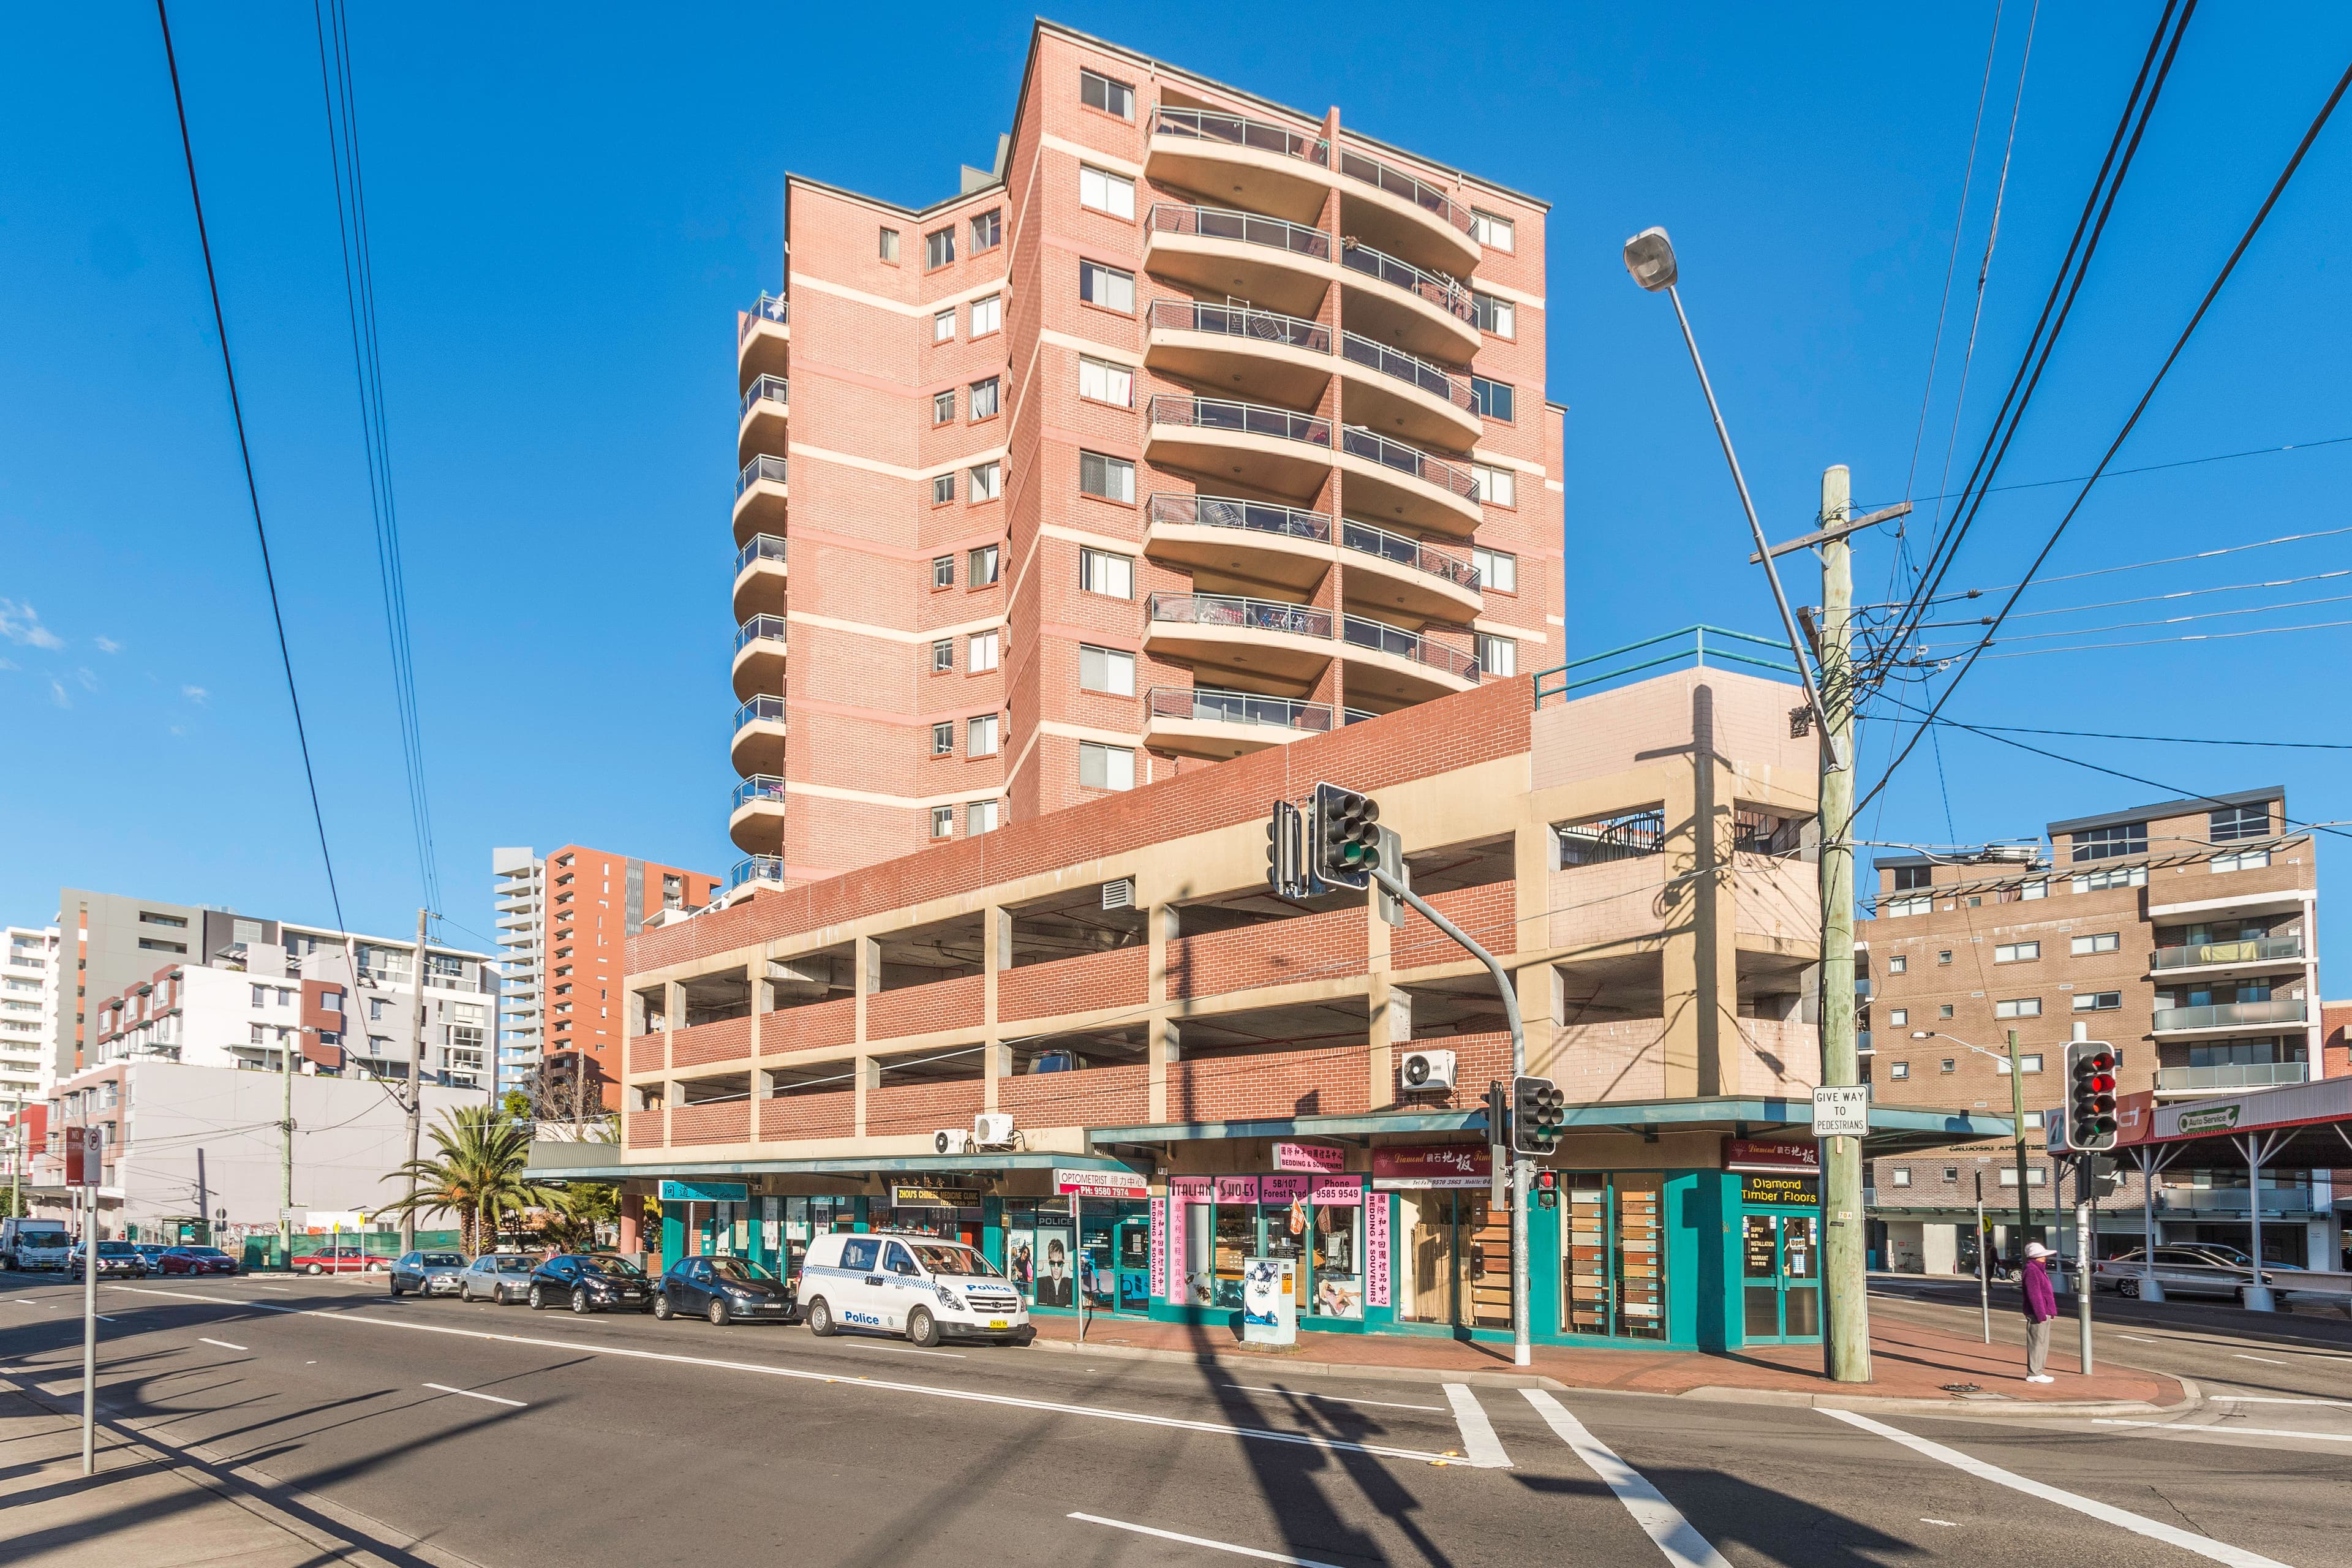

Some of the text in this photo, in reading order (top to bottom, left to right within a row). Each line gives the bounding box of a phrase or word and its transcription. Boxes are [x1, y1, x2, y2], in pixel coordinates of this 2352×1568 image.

[1817, 1092, 1864, 1102] GIVE WAY
[1834, 1106, 1845, 1115] TO
[1817, 1120, 1863, 1129] PEDESTRIANS
[2203, 1115, 2226, 1124] Service
[72, 1131, 79, 1139] NO
[1395, 1152, 1425, 1164] Diamond
[1061, 1172, 1107, 1185] OPTOMETRIST
[1110, 1175, 1143, 1187] 視力中心
[1273, 1179, 1297, 1188] 5B/107
[1753, 1178, 1801, 1189] Diamond
[899, 1189, 917, 1199] ZHOU'S
[919, 1190, 939, 1199] CHINESE
[1094, 1186, 1110, 1195] 9580
[1112, 1188, 1129, 1196] 7974
[1317, 1189, 1358, 1198] 9585 9549
[1741, 1189, 1817, 1202] Timber Floors
[966, 1284, 1011, 1292] Police
[845, 1311, 880, 1325] Police
